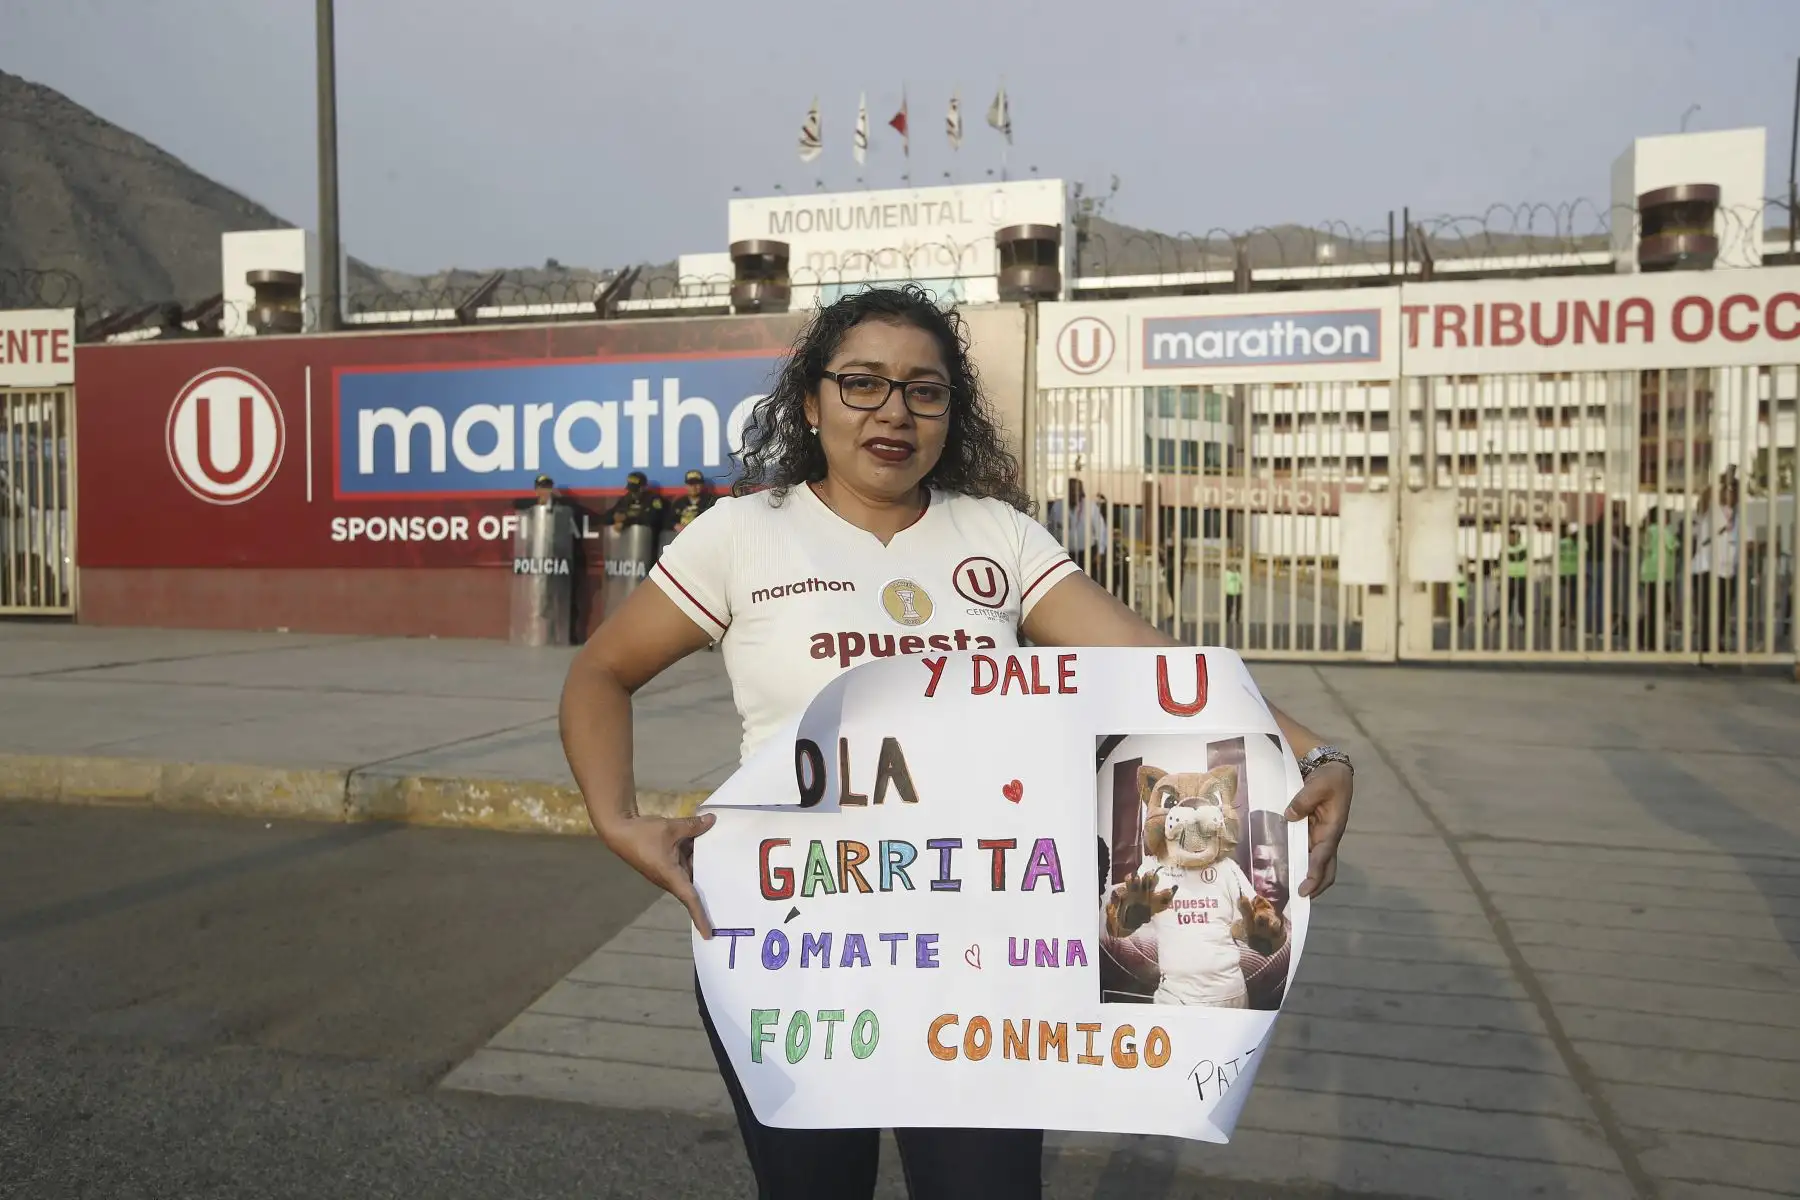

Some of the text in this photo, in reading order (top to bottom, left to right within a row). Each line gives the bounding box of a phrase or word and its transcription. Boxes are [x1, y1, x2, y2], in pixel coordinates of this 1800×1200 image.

[769, 200, 973, 234] MONUMENTAL
[1070, 320, 1370, 368] U marathon
[1401, 291, 1800, 349] TRIBUNA OCC
[196, 397, 254, 484] U
[331, 516, 469, 541] SPONSOR
[514, 558, 569, 575] POLICIA
[751, 577, 856, 604] marathon
[966, 567, 997, 598] U
[810, 629, 996, 668] apuesta
[921, 653, 1209, 718] Y DALE U
[795, 737, 919, 809] OLA
[758, 838, 1065, 901] GARRITA
[711, 906, 1089, 971] TÓMATE UNA
[1177, 911, 1210, 925] total
[750, 1008, 1172, 1070] FOTO CONMIGO
[1187, 1047, 1257, 1101] PAT
